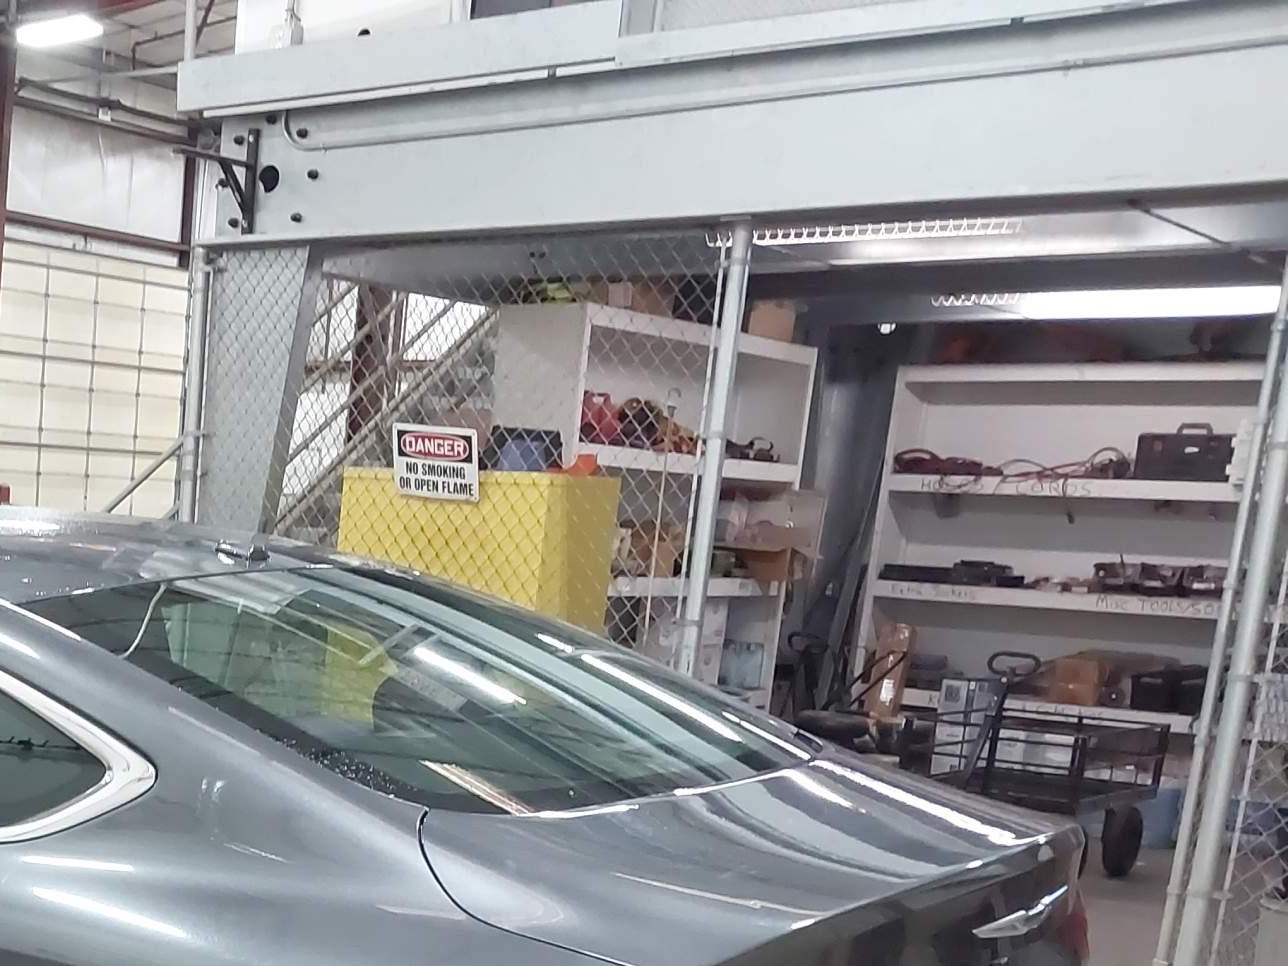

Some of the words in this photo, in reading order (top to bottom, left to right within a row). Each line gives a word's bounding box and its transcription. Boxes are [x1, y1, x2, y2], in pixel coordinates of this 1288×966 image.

[405, 437, 464, 456] DANGER
[406, 461, 418, 475] NO
[422, 463, 465, 480] SMOKING
[400, 476, 411, 490] OR
[414, 478, 439, 492] OPEN
[442, 481, 474, 496] FLAME
